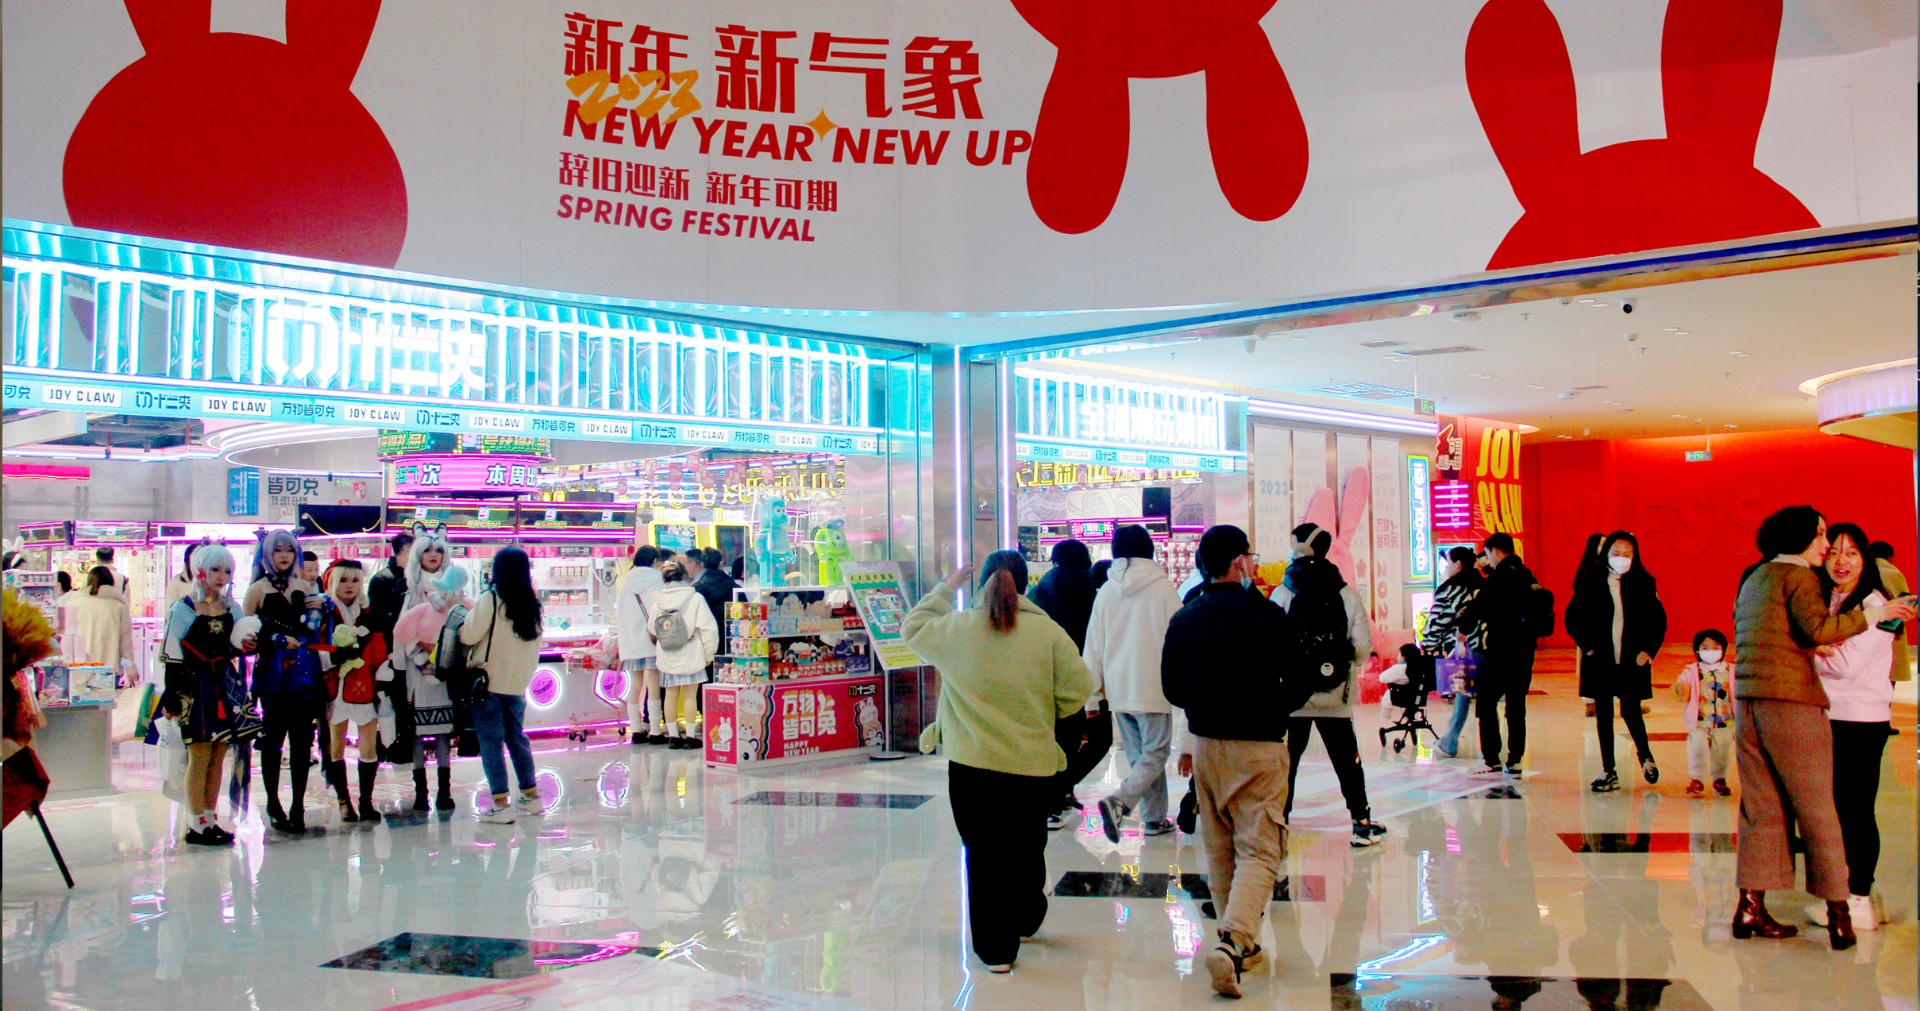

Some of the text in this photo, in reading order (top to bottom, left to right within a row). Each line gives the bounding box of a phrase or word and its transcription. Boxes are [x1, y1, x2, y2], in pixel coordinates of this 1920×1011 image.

[564, 12, 984, 119] 新年 新气象
[566, 69, 702, 125] 2023
[563, 99, 1032, 167] NEW YEAR NEW UP
[559, 151, 838, 212] 辞旧迎新 新年可期
[556, 194, 815, 242] SPRING FESTIVAL
[50, 389, 72, 401] JOY
[76, 390, 116, 404] CLAW
[208, 398, 227, 410] JOY
[232, 400, 267, 413] CLAW
[349, 408, 367, 419] JOY
[370, 409, 401, 421] CLAW
[473, 416, 489, 427] JOY
[493, 417, 521, 429] CLAW
[586, 424, 601, 433] JOY
[604, 424, 628, 435] CLAW
[687, 430, 699, 439] JOY
[702, 430, 725, 440] CLAW
[1476, 427, 1521, 480] JOY
[1259, 479, 1288, 496] 2023
[1477, 481, 1523, 533] CLAW
[784, 740, 809, 750] HAPPY
